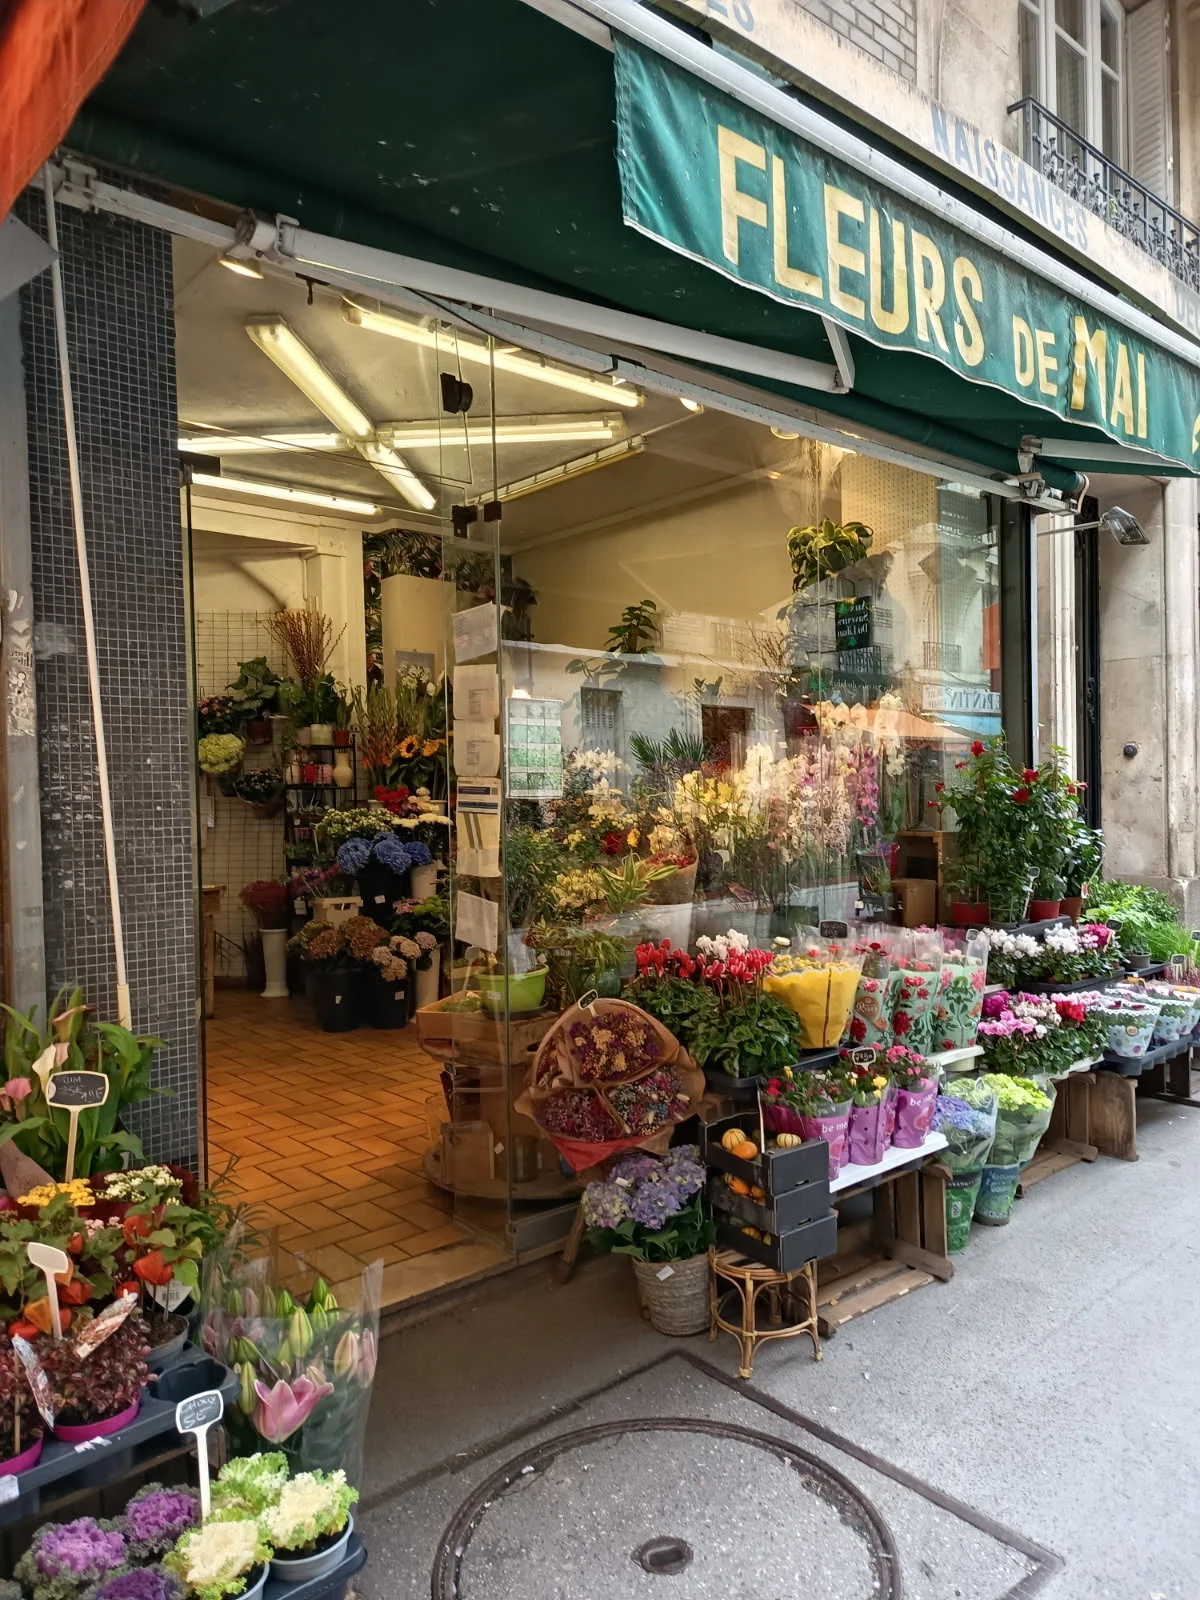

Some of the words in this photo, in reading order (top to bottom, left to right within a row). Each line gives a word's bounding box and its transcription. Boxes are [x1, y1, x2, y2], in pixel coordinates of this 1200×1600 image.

[718, 124, 985, 367] FLEURS
[1012, 314, 1058, 397] DE
[1070, 315, 1147, 439] MAI
[931, 103, 1088, 250] NAISSANCES
